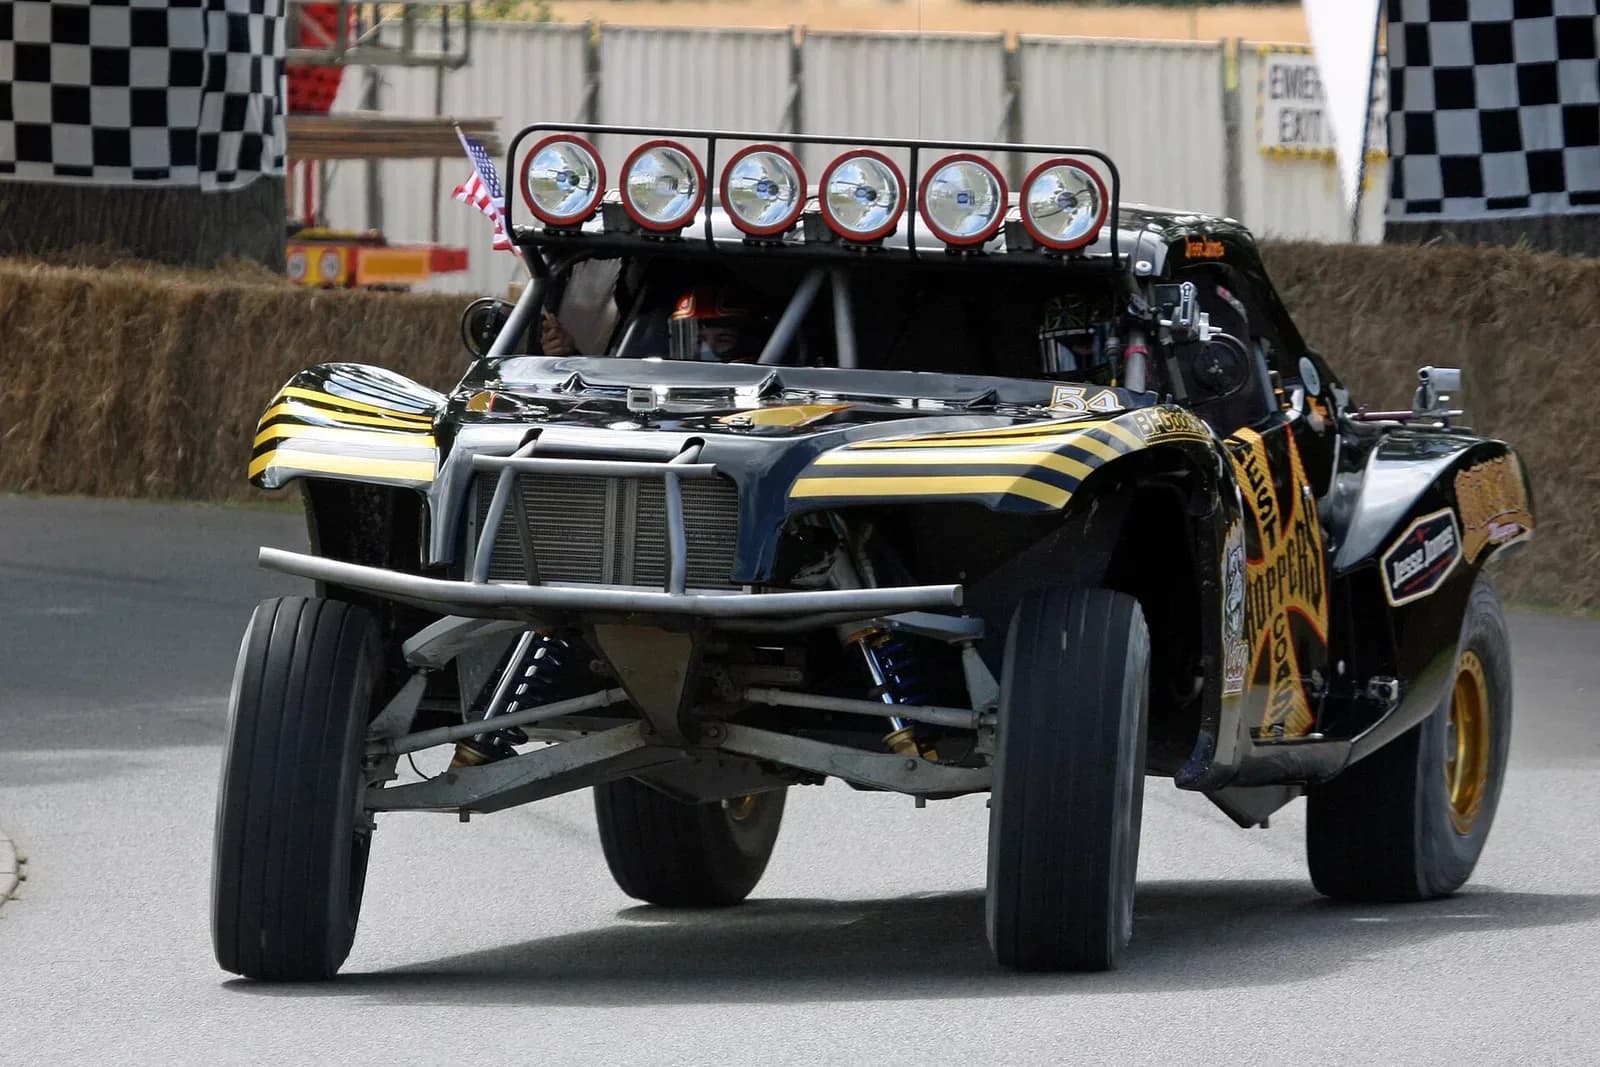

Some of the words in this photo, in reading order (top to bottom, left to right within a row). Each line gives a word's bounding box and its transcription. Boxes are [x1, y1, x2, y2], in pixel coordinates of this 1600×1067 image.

[1280, 108, 1322, 142] EXIT
[1051, 386, 1125, 413] 54
[1223, 435, 1277, 549] WEST
[1245, 480, 1323, 664] HOPPERS
[1393, 548, 1424, 589] Jesse
